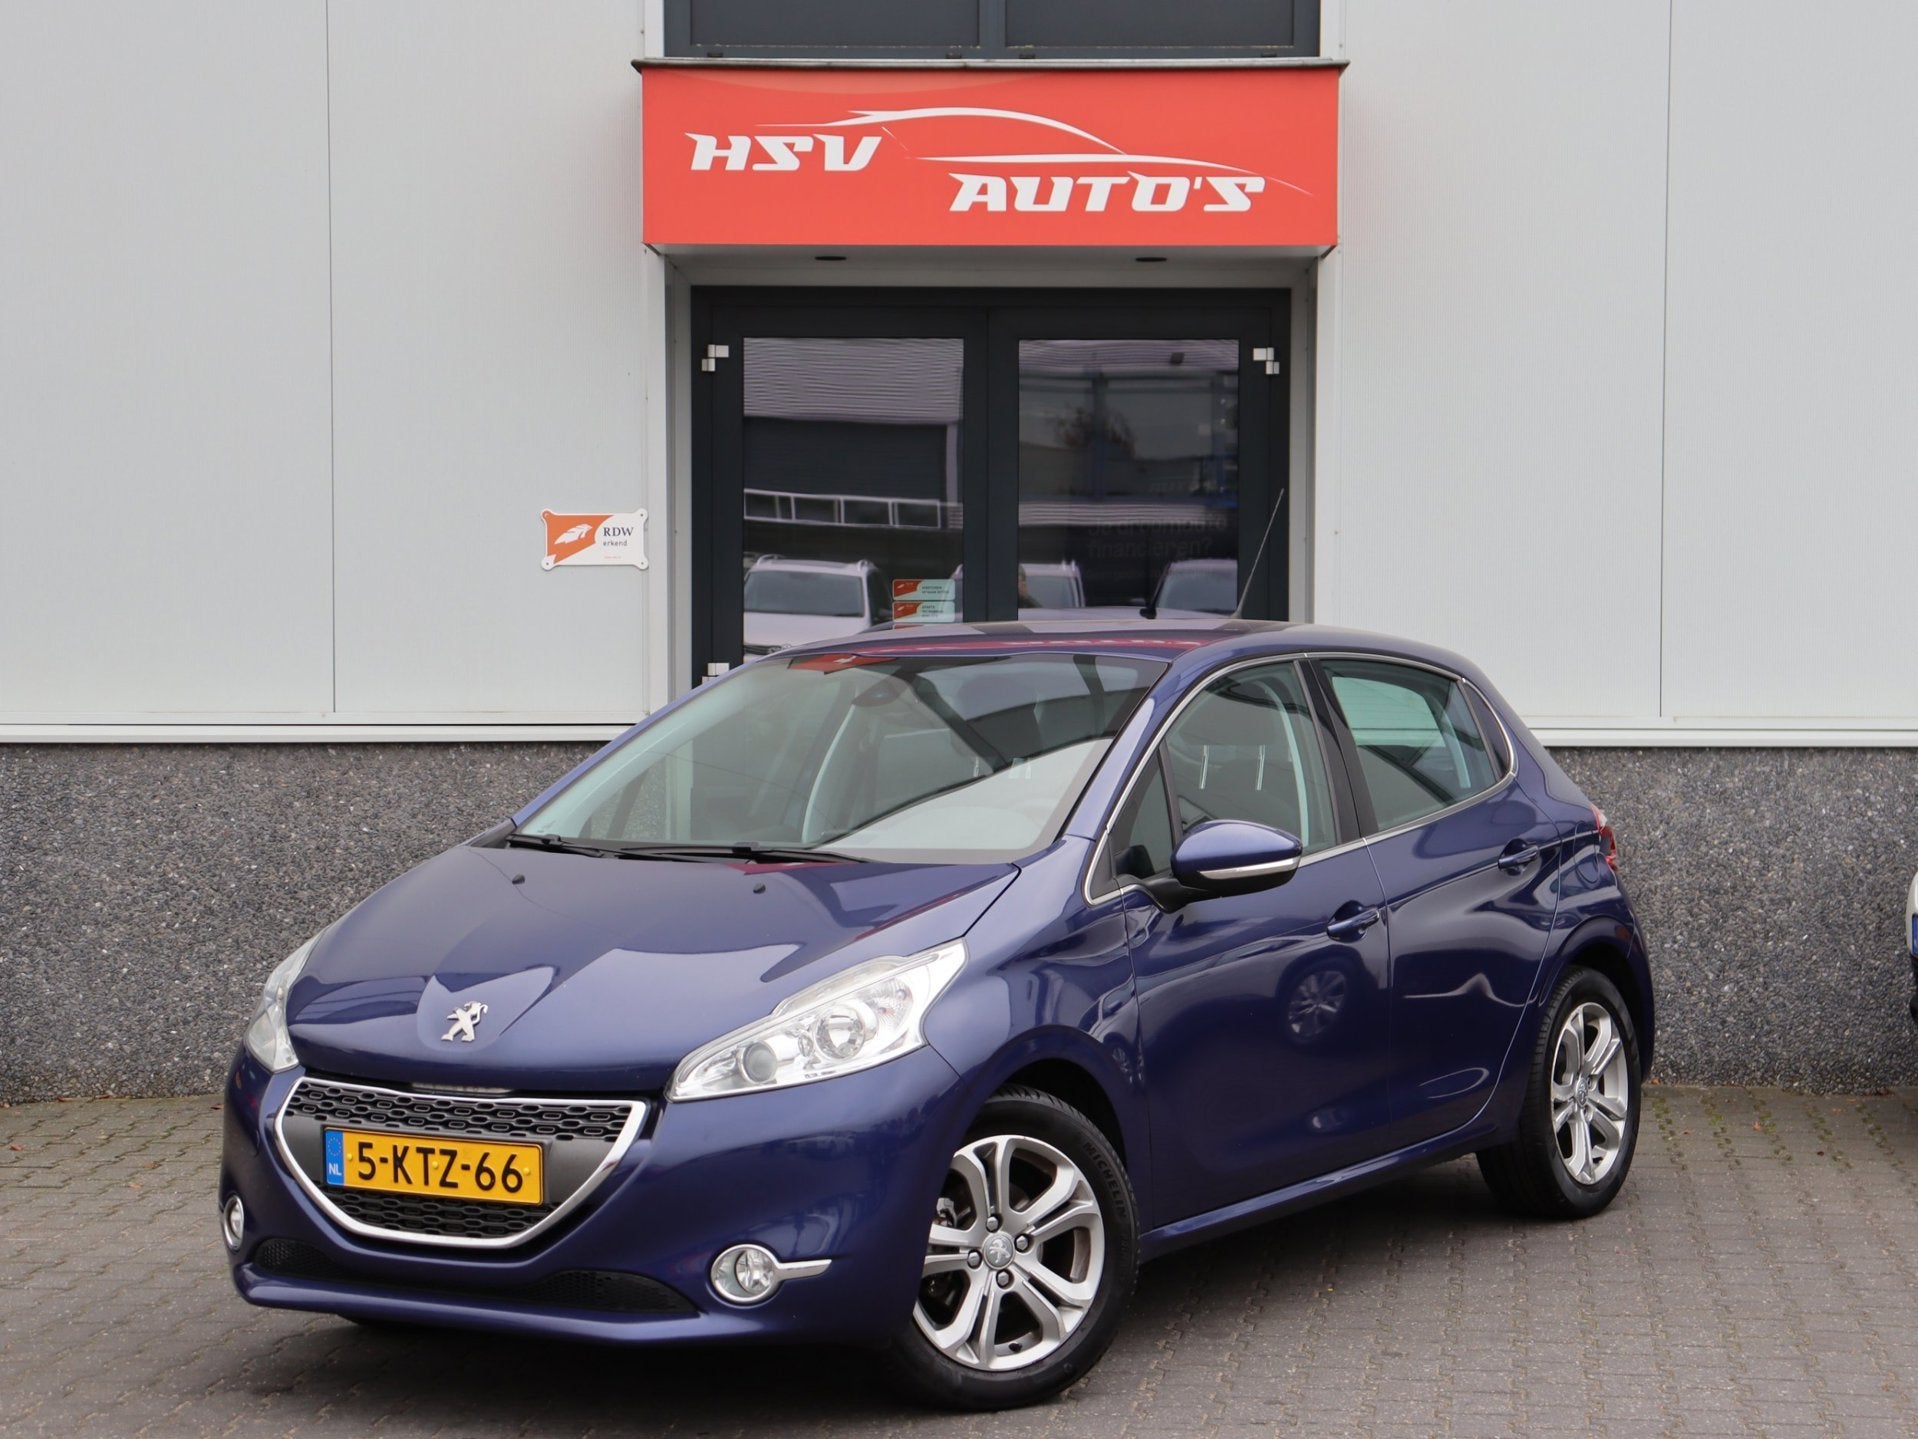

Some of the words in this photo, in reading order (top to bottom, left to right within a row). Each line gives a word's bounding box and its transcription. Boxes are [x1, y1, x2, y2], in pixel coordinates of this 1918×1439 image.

[684, 132, 883, 172] HSV
[948, 171, 1266, 213] AUTO'S
[603, 526, 634, 537] RDW
[603, 539, 628, 547] erkend
[328, 1162, 342, 1177] NL
[357, 1141, 524, 1194] 5-KTZ-66
[1083, 1141, 1127, 1219] MICHELIN
